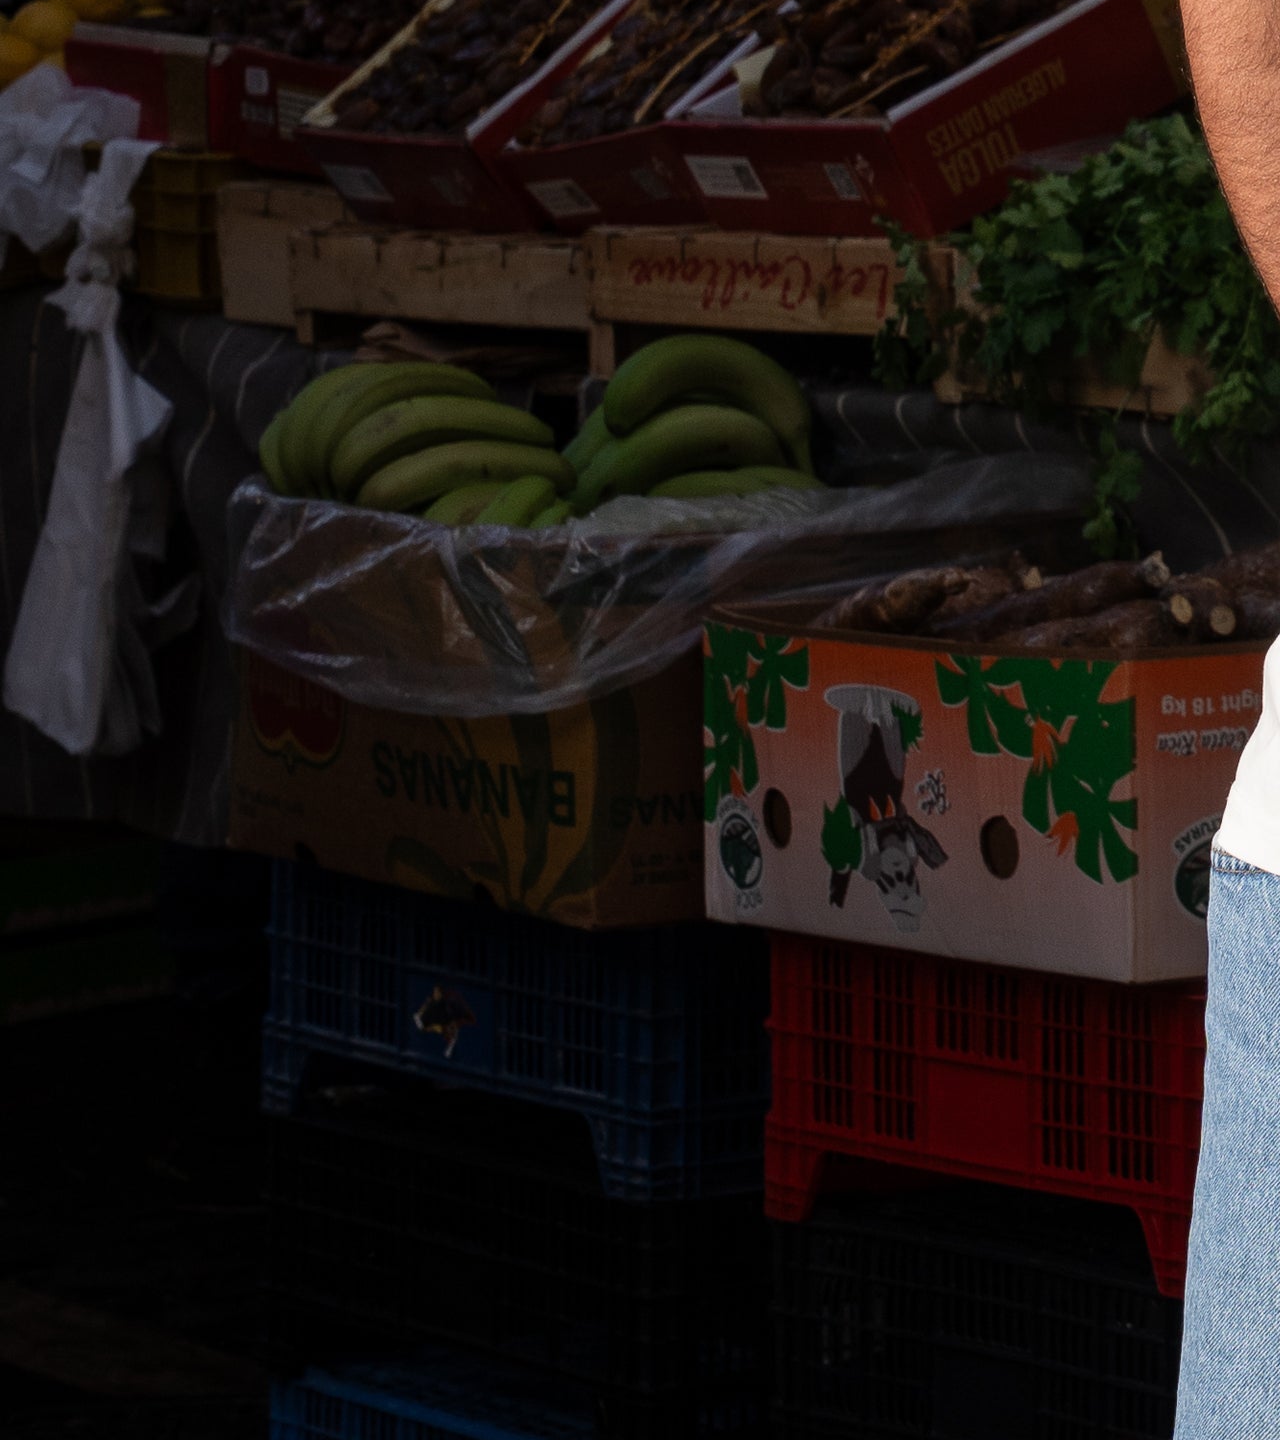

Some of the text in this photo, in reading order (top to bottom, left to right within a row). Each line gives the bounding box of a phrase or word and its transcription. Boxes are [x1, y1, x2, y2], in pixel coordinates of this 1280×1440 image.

[925, 56, 1067, 159] ALGERIAN DATES
[937, 121, 1021, 197] TOLGA
[371, 740, 578, 829] BANANAS
[1175, 817, 1221, 854] TURAS
